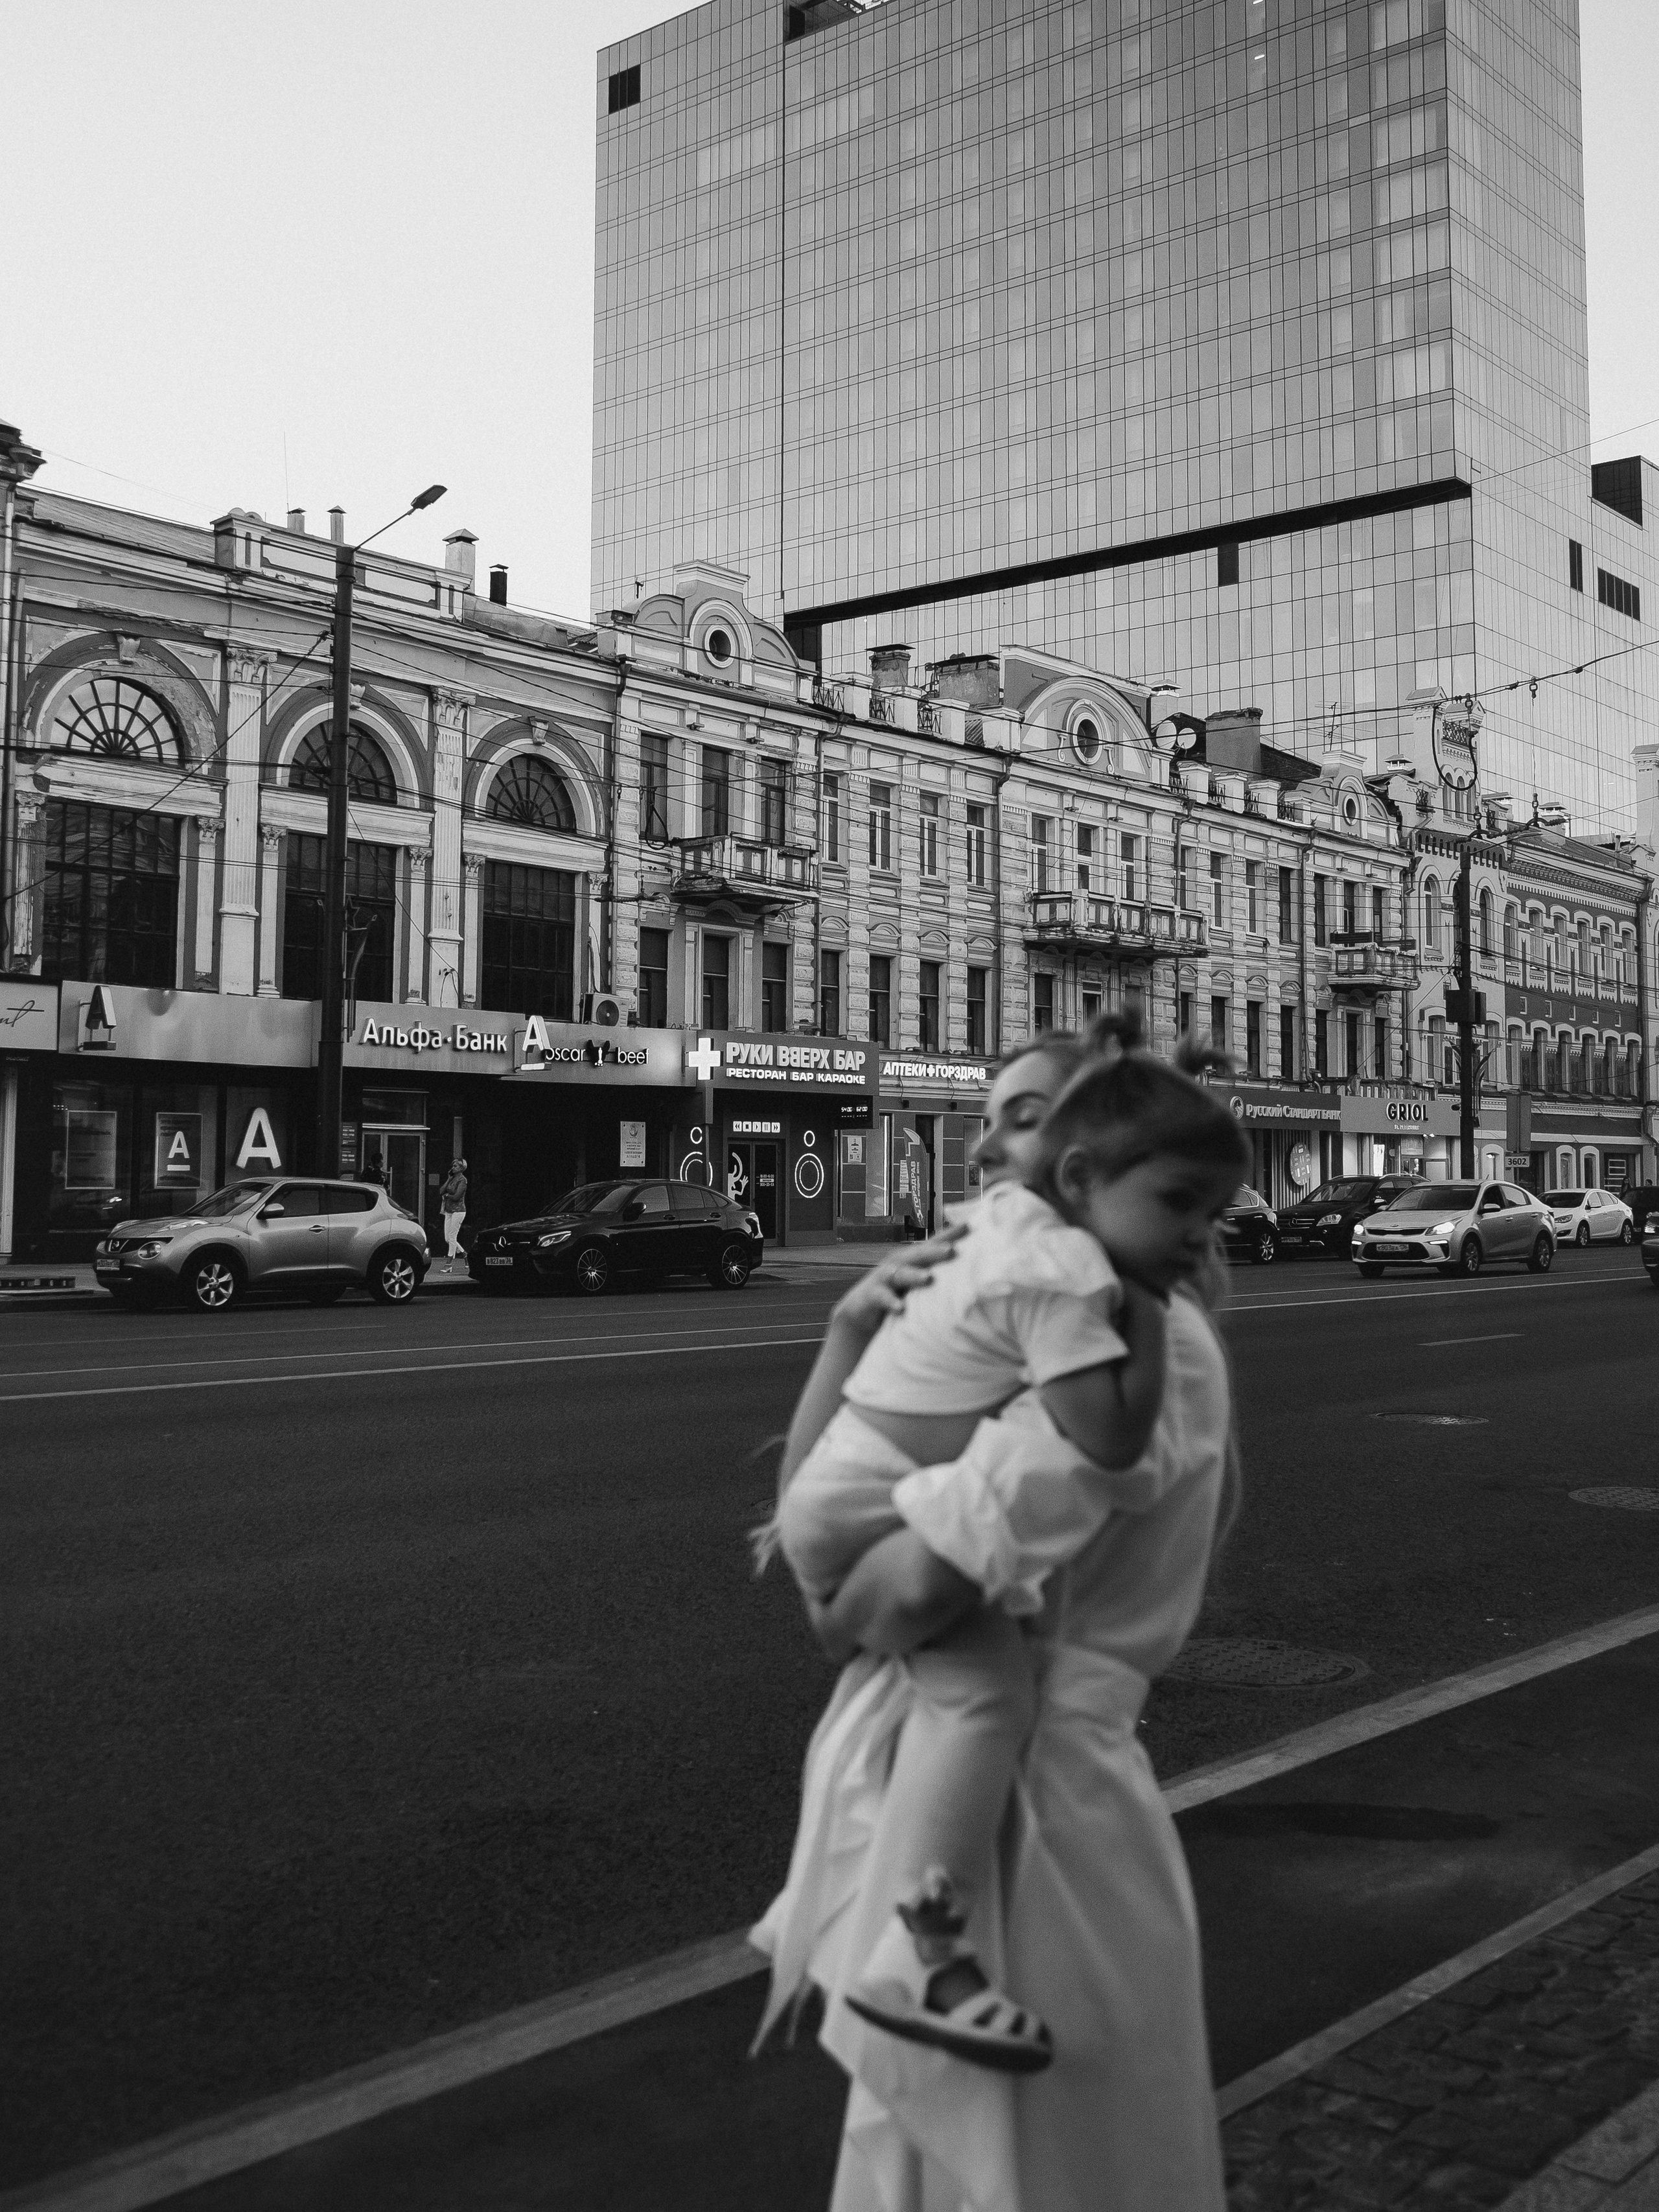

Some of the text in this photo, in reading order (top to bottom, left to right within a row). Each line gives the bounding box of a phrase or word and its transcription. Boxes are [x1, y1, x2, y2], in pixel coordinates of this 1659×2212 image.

[545, 1046, 649, 1064] oscar beef
[726, 1042, 774, 1065] РУКИ
[833, 1049, 866, 1071] БАР
[726, 1067, 866, 1085] РЕСТОРАН БАР КАРАОКЕ
[883, 1062, 986, 1081] АПТЕКИ ГОРЗДРАВ
[1386, 1102, 1428, 1121] GRIOL
[911, 1161, 920, 1209] ГОРЗДРАВ
